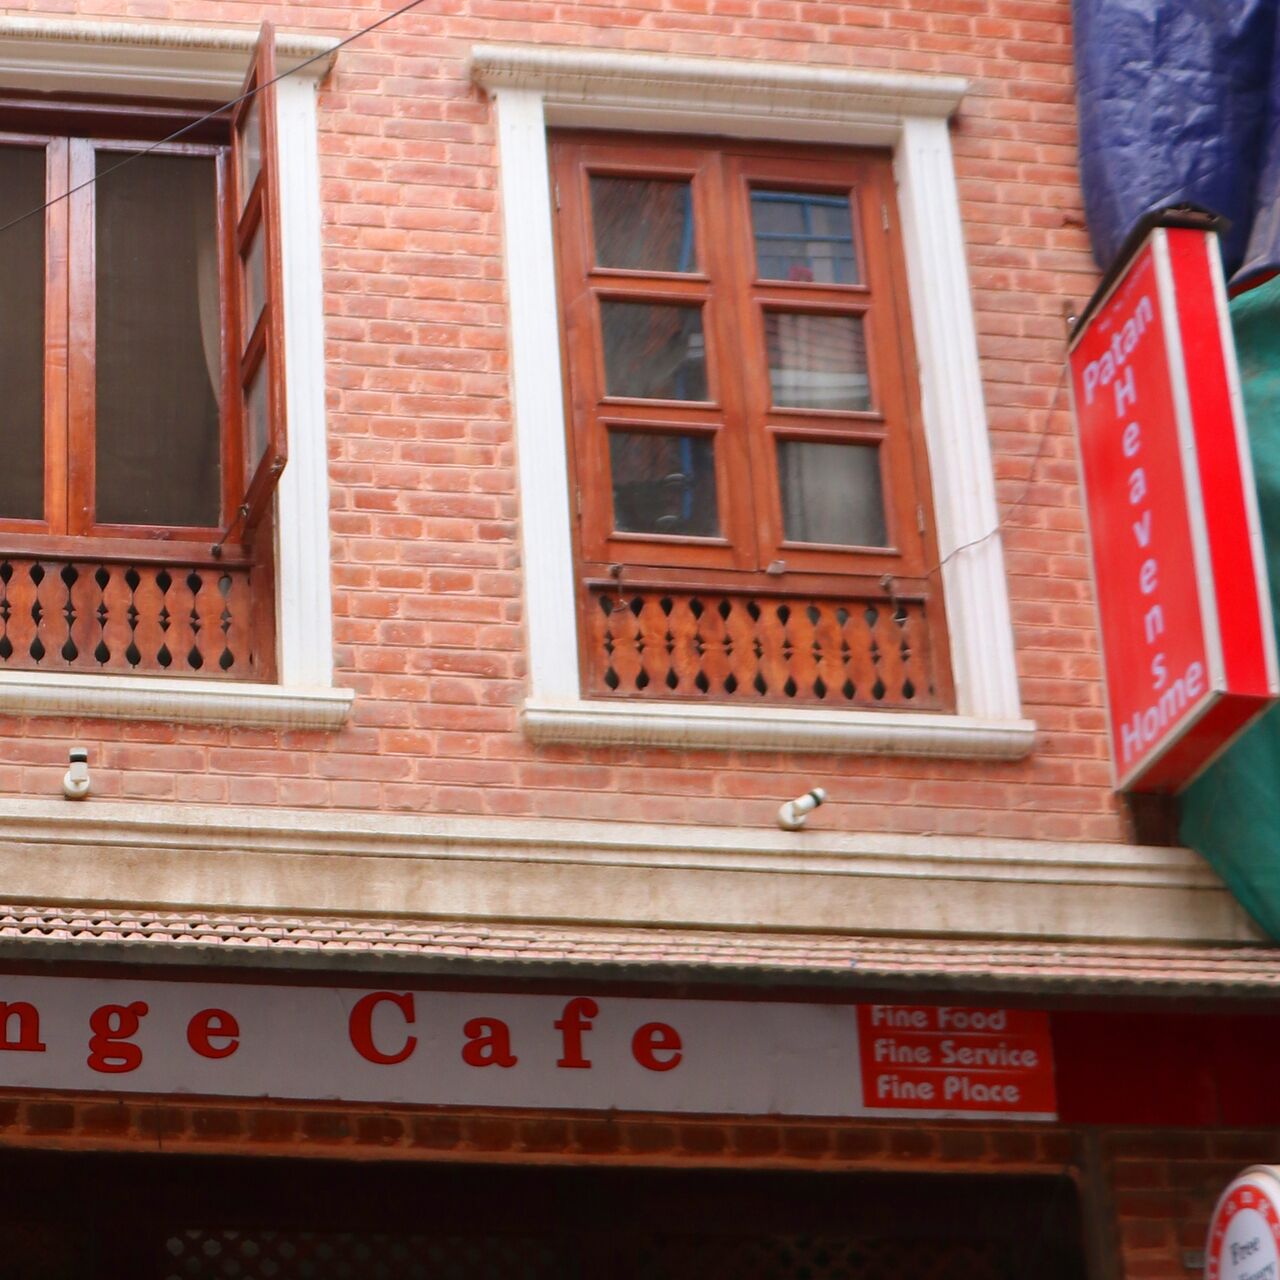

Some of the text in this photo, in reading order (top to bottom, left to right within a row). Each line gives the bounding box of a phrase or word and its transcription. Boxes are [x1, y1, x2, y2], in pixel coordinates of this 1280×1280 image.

[1083, 296, 1153, 404] Patan
[1114, 366, 1166, 690] Heavens
[1122, 661, 1204, 763] Home
[348, 989, 685, 1073] Cafe
[872, 1005, 1008, 1031] Fine Food
[875, 1038, 1039, 1067] Fine Service
[877, 1074, 1021, 1103] Fine Place
[1231, 1237, 1260, 1266] Free
